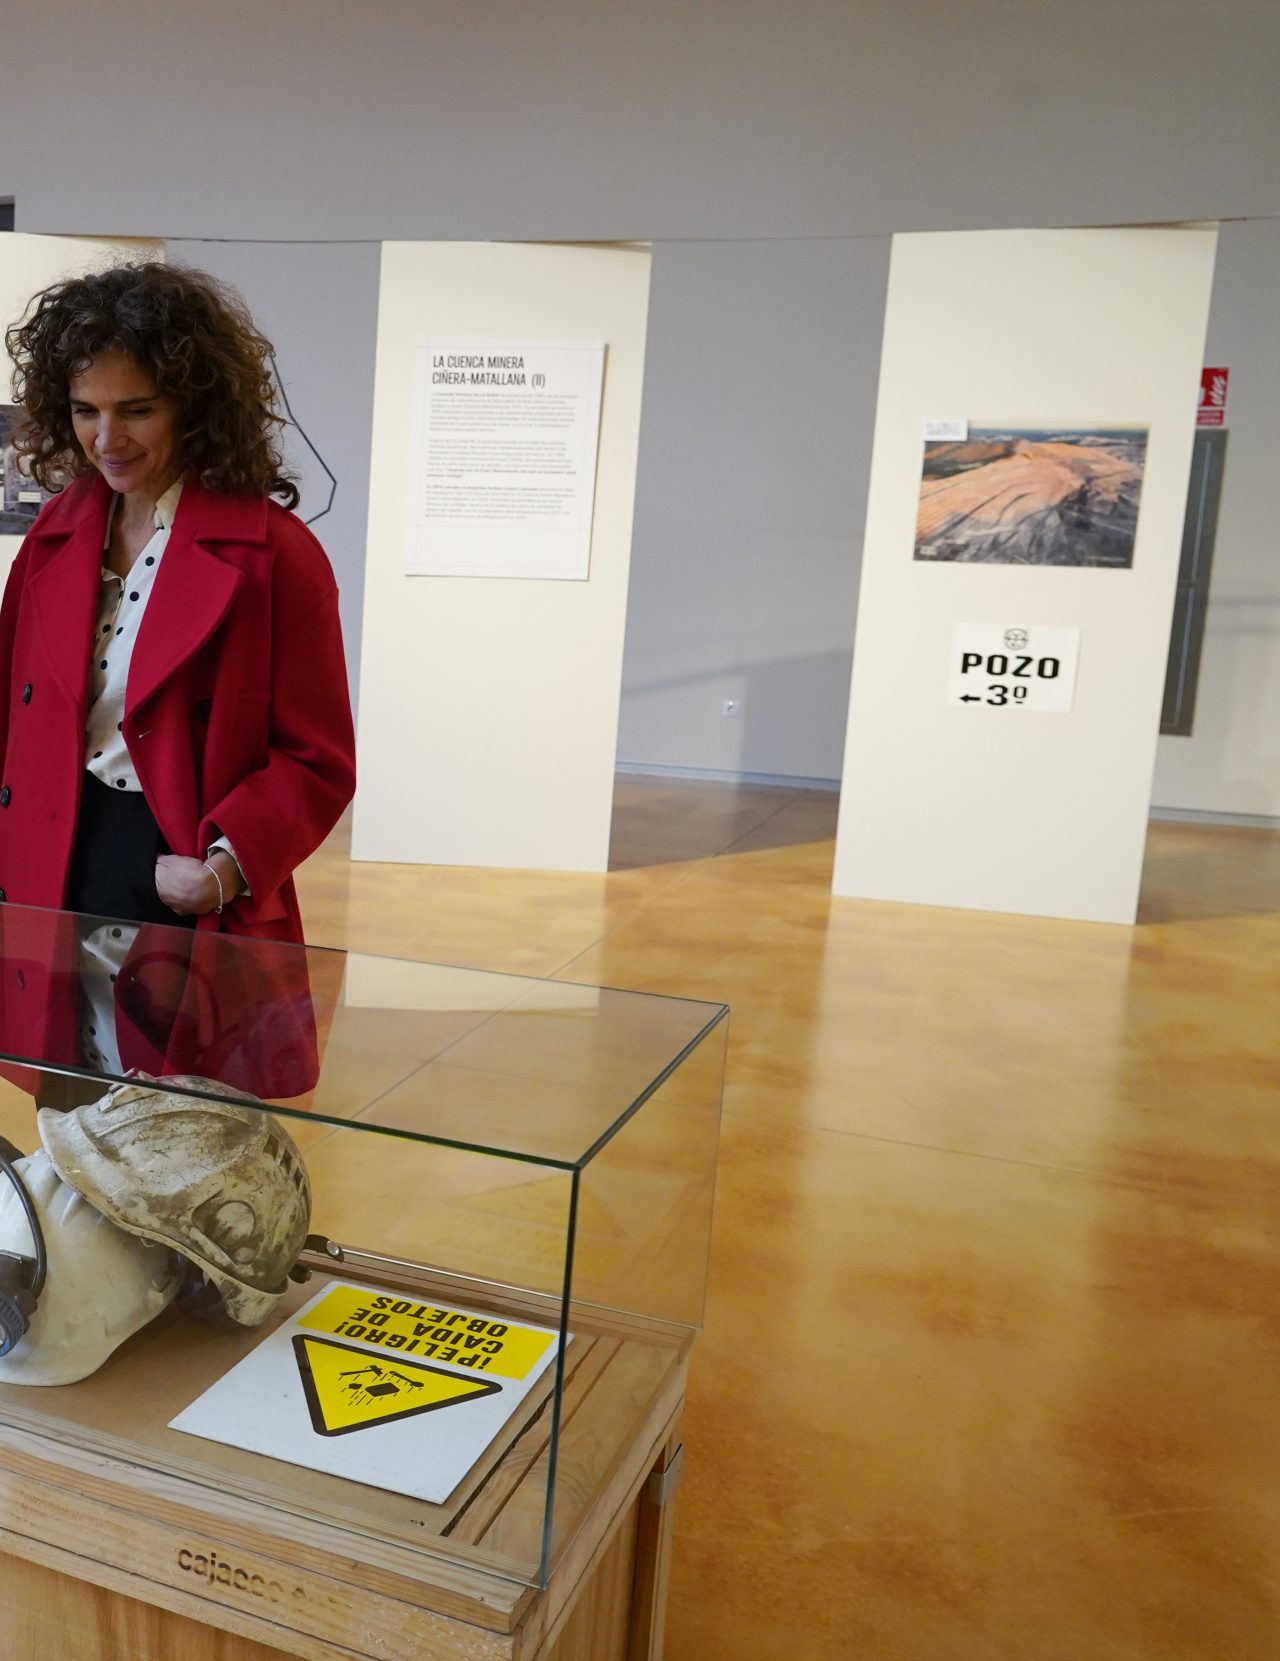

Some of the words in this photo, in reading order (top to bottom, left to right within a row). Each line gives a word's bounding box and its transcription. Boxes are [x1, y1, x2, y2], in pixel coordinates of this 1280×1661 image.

[433, 355, 444, 368] LA
[447, 355, 484, 368] CUENCA
[487, 356, 524, 369] MINERA
[432, 369, 526, 385] CIÑERA-MATALLANA
[961, 652, 1060, 679] POZO
[348, 1307, 391, 1327] DE
[370, 1296, 509, 1337] OBJETOS
[333, 1321, 493, 1370] ¡PELIGRO!
[412, 1322, 504, 1354] CAIDA
